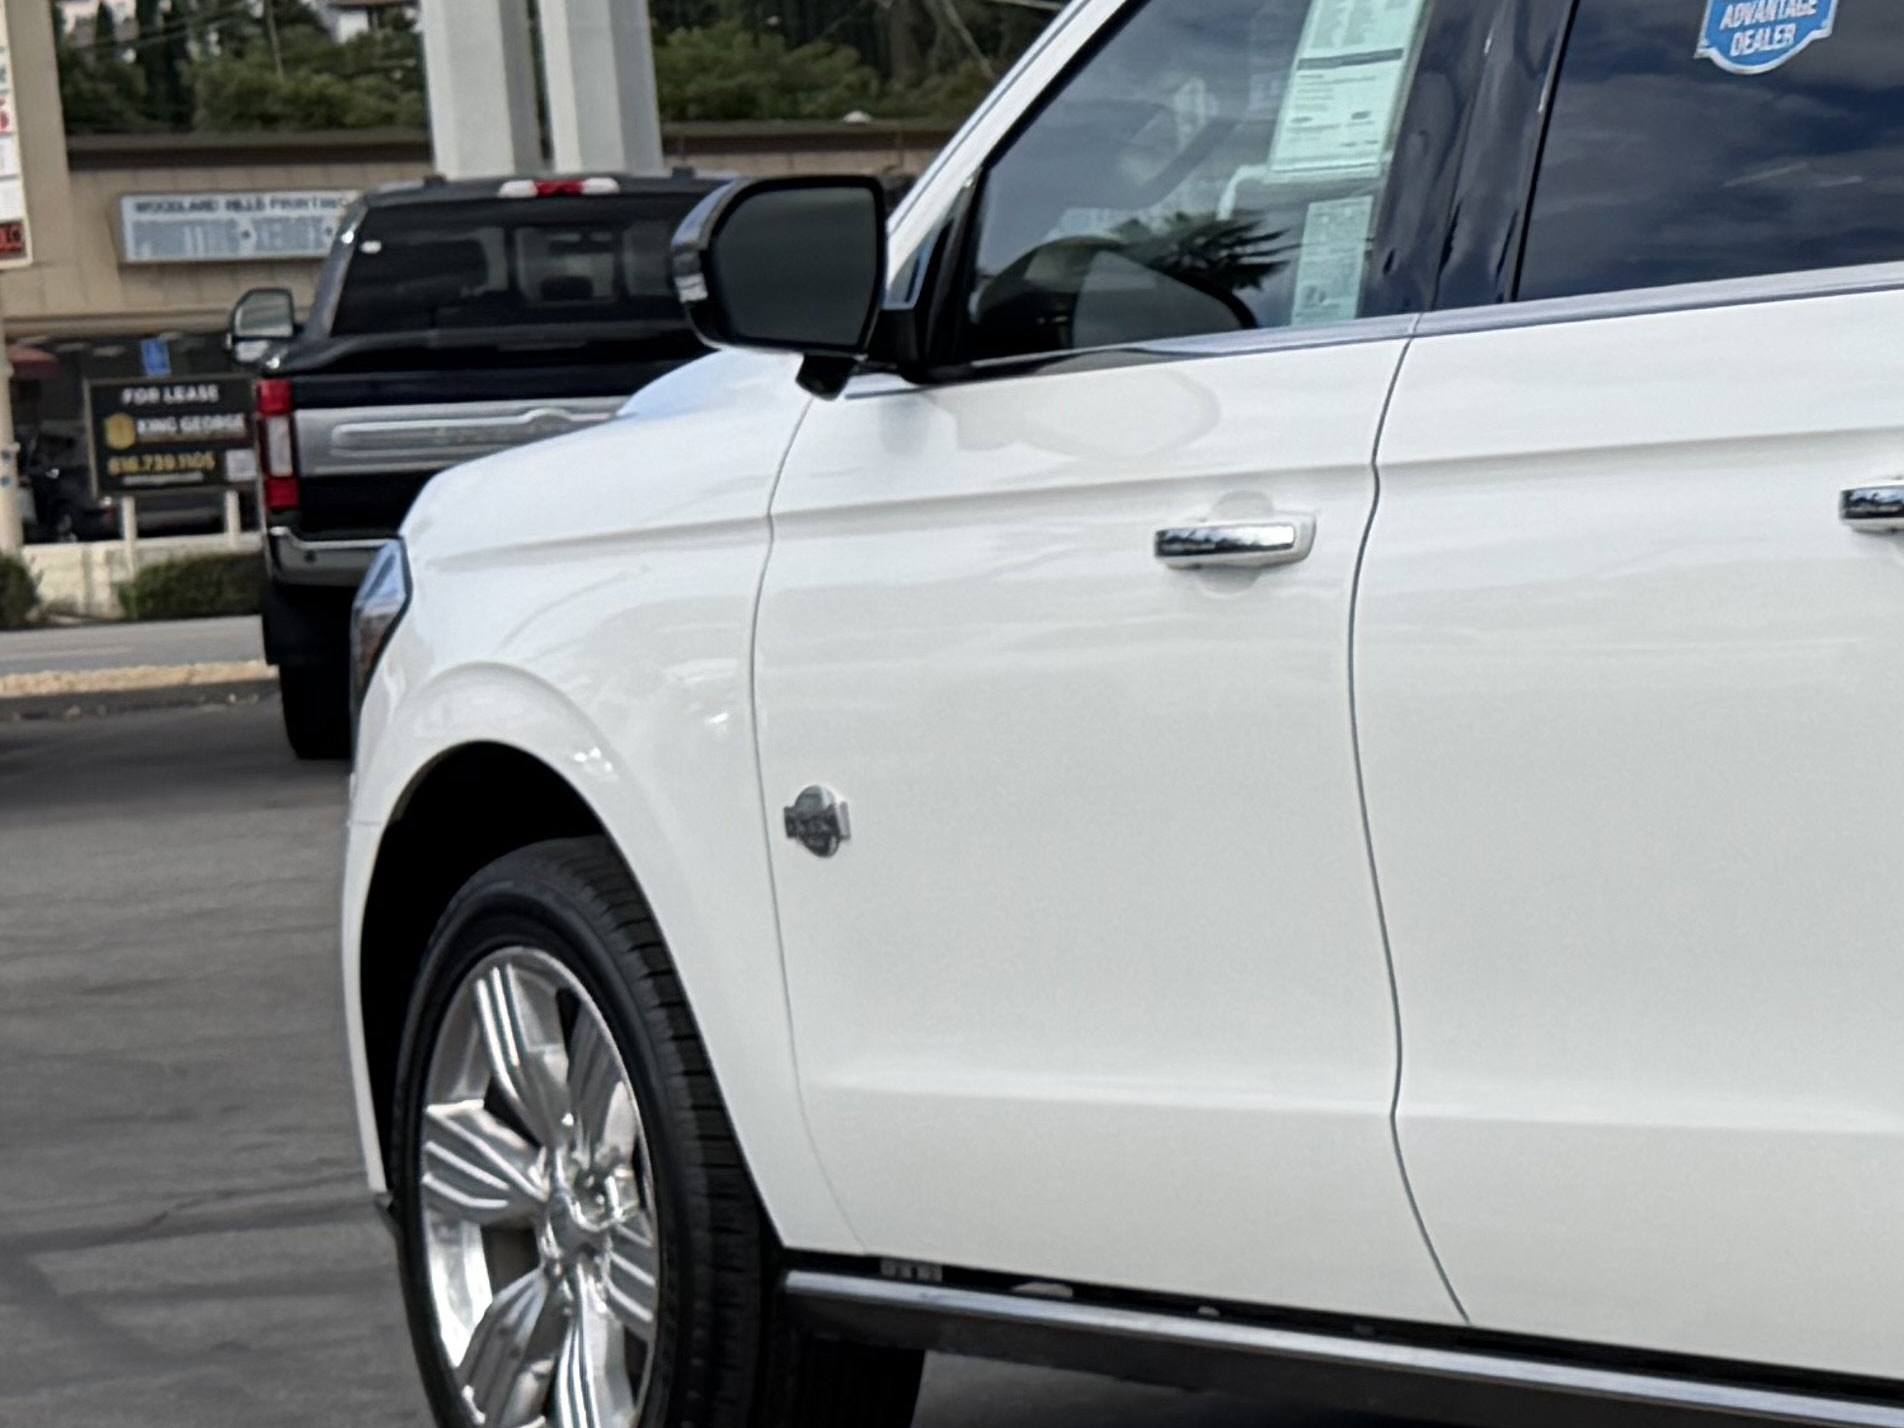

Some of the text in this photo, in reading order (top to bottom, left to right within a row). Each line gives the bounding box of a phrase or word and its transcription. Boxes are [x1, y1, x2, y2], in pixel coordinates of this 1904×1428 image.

[1730, 23, 1797, 57] DEALER
[121, 383, 219, 405] FOR LEASE
